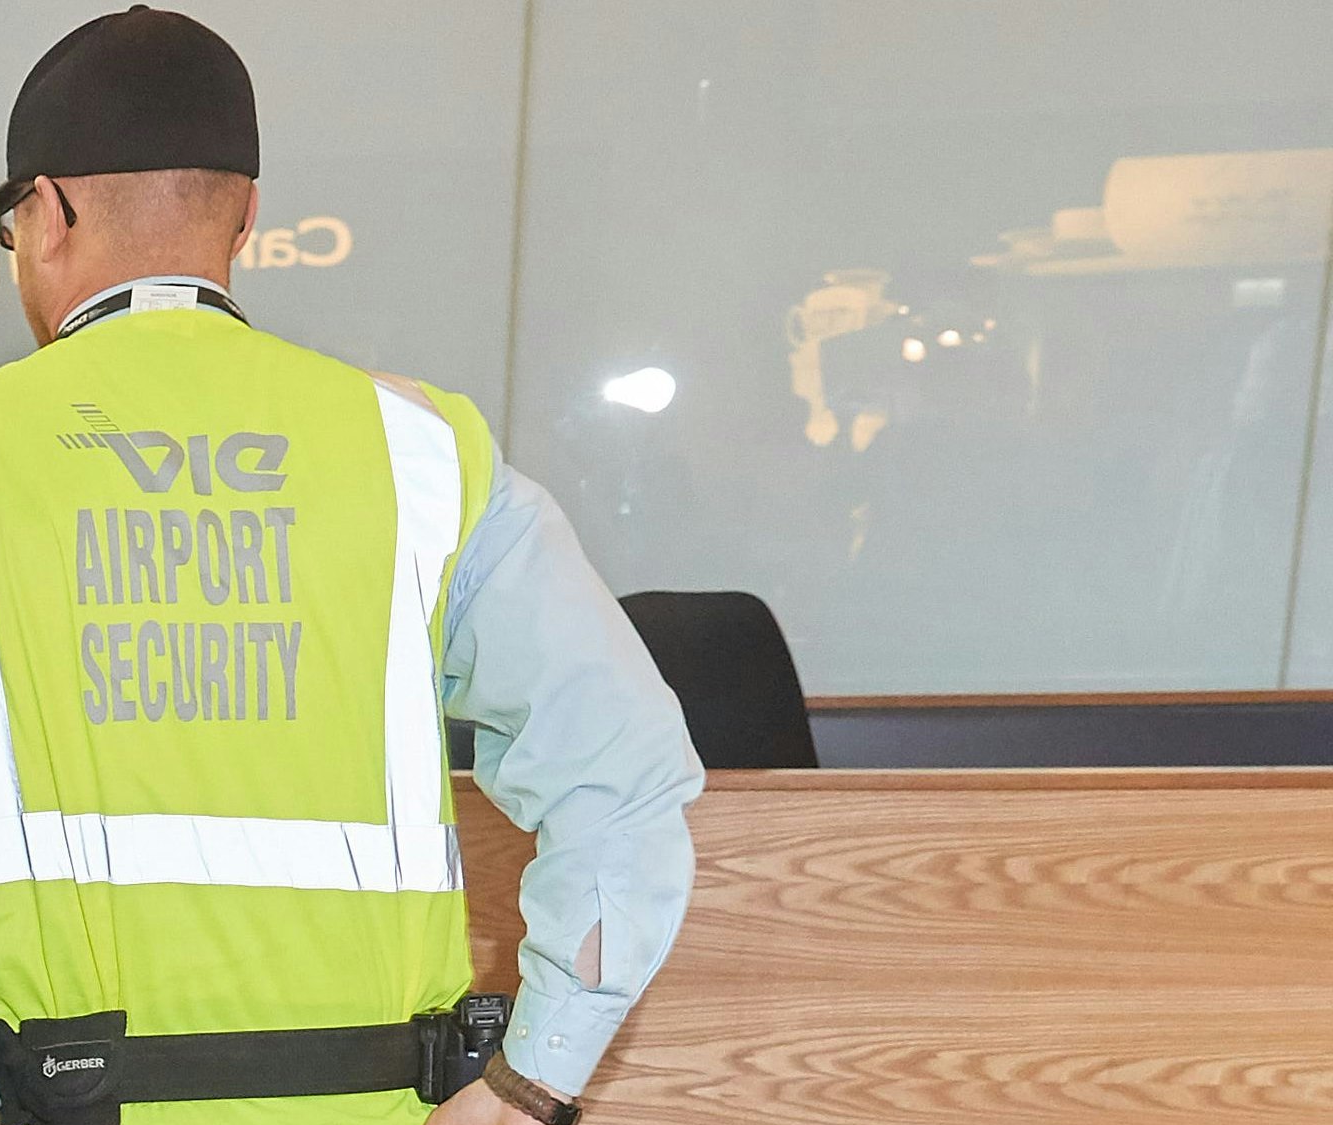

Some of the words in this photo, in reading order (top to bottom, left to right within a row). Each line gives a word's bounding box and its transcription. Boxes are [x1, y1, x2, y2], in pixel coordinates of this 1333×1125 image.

[75, 507, 296, 606] AIRPORT
[81, 620, 302, 726] SECURITY
[56, 1057, 105, 1072] GERBER
